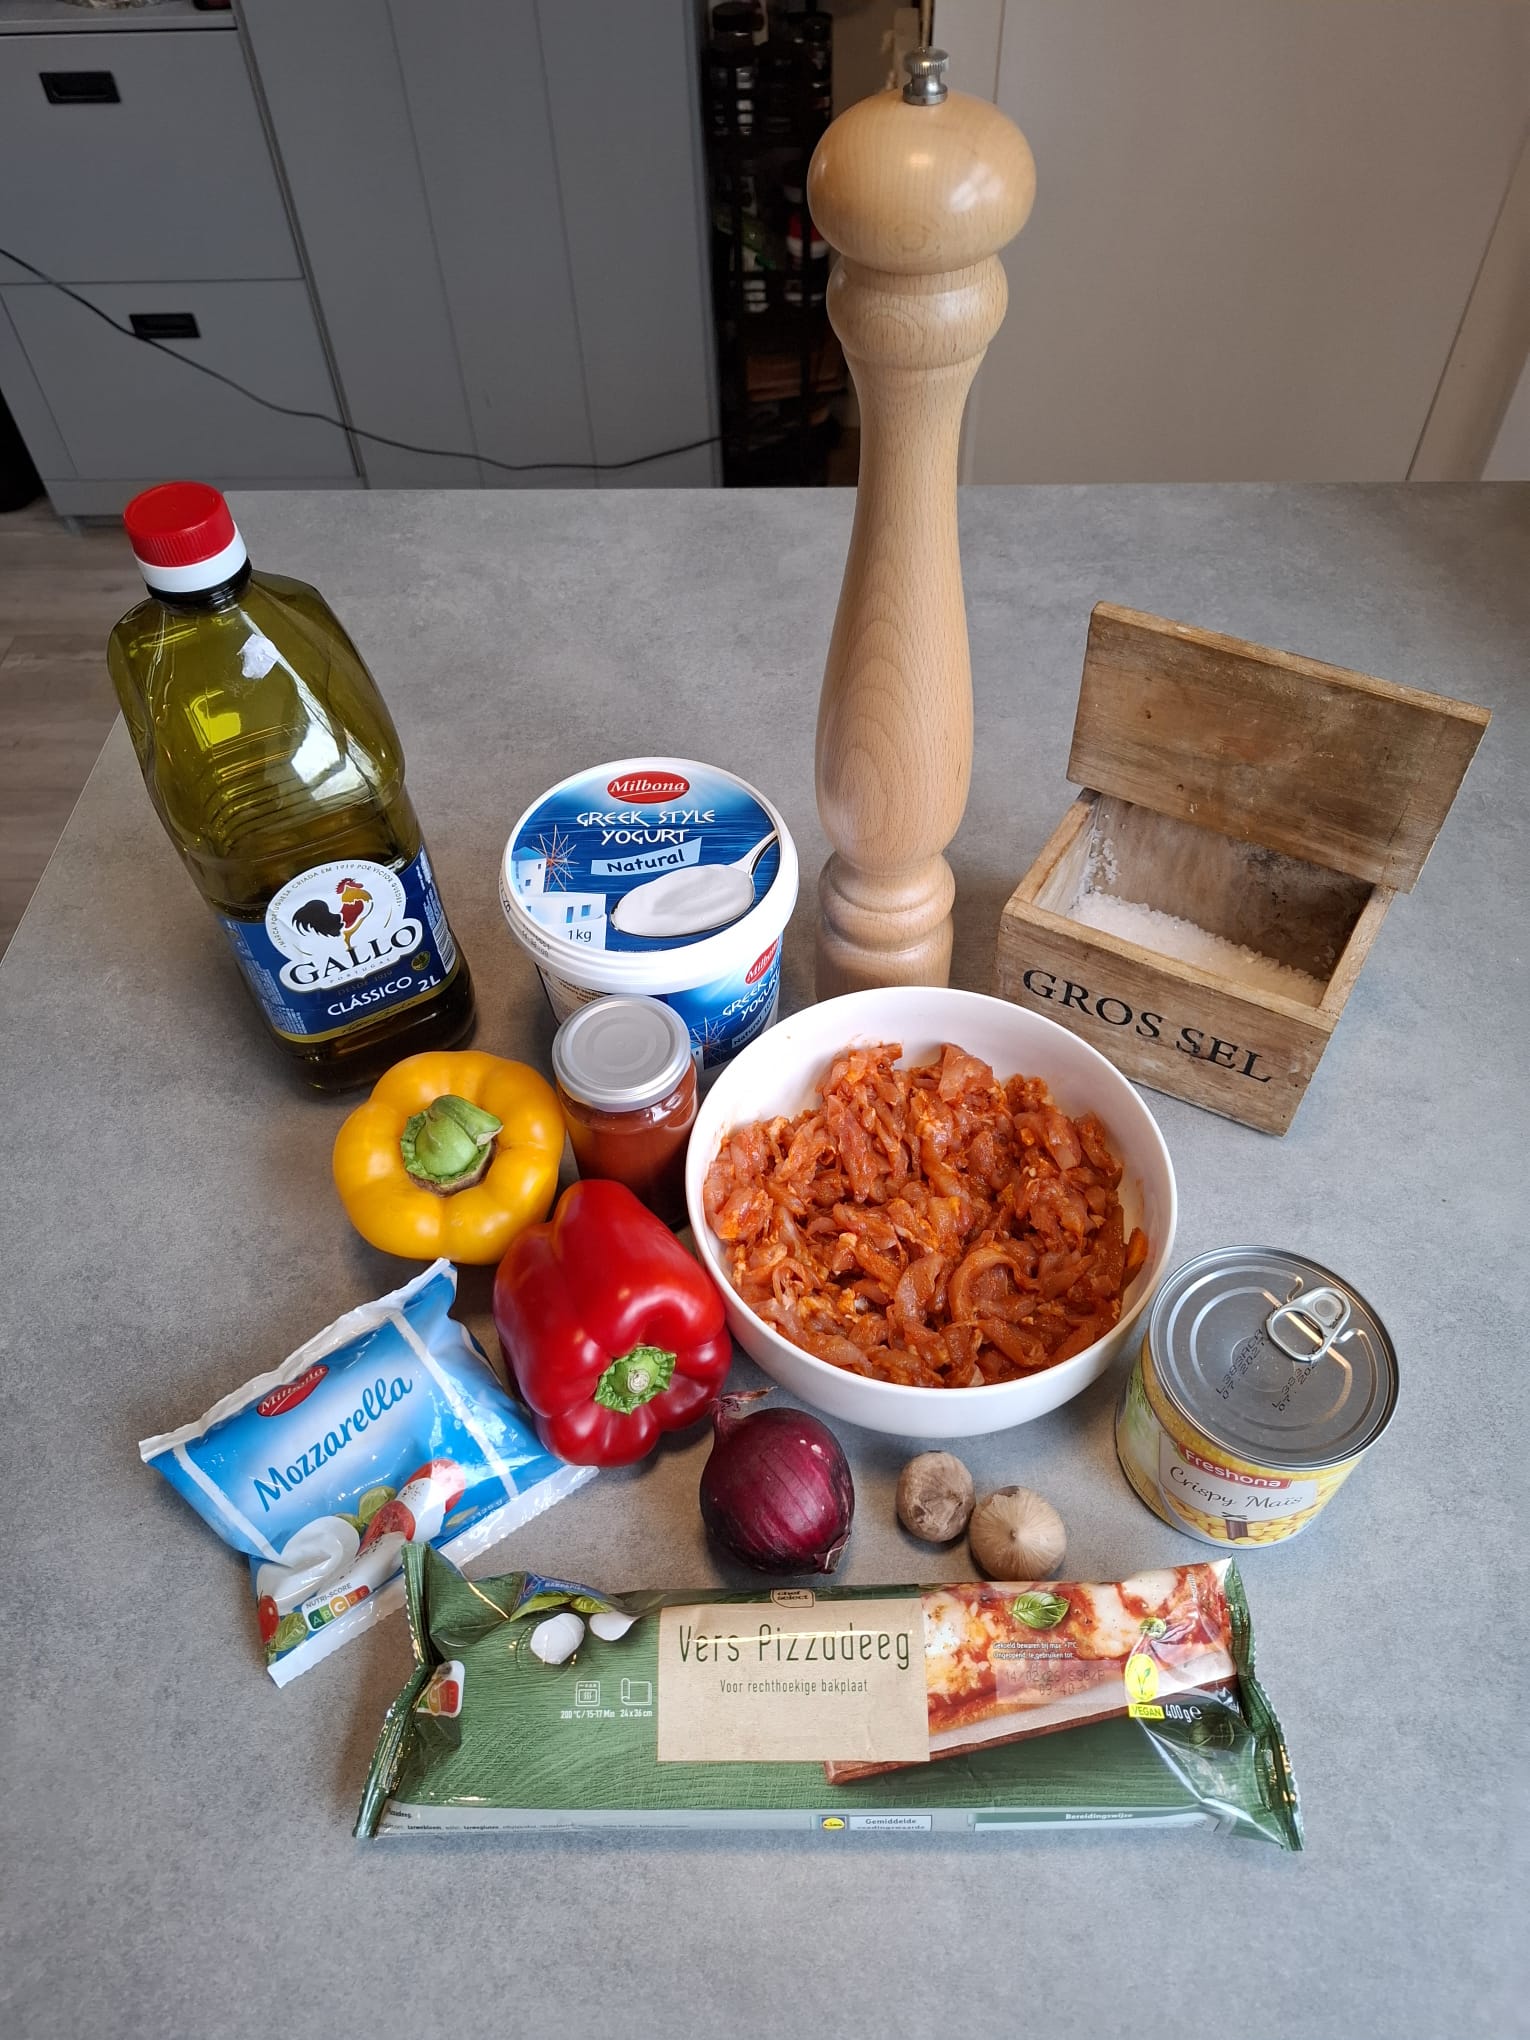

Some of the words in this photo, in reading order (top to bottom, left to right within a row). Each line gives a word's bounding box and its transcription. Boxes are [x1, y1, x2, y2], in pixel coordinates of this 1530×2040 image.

[610, 779, 686, 793] Milbona
[576, 811, 651, 828] GREEK
[658, 809, 716, 824] STYLE
[600, 829, 690, 846] YOGURT
[321, 867, 332, 875] EM
[607, 849, 685, 873] Natural
[289, 925, 417, 985] GALLO
[327, 976, 412, 1016] CLÁSSICO
[417, 975, 441, 993] 2L
[722, 980, 767, 1016] GREEK
[1023, 969, 1164, 1039] GROS
[1176, 1027, 1272, 1083] SEL
[253, 1377, 413, 1512] Mozzarella
[1185, 1449, 1281, 1488] Freshona
[1170, 1466, 1237, 1507] Crispy
[305, 1583, 352, 1609] NUTRI-SCORE
[334, 1601, 346, 1612] C
[679, 1625, 740, 1662] Vers
[759, 1622, 911, 1671] Pizzadeeg
[720, 1679, 743, 1693] Voor
[748, 1679, 817, 1696] rechthoekige
[821, 1678, 868, 1696] bakplaat
[1132, 1706, 1162, 1718] VEGAN
